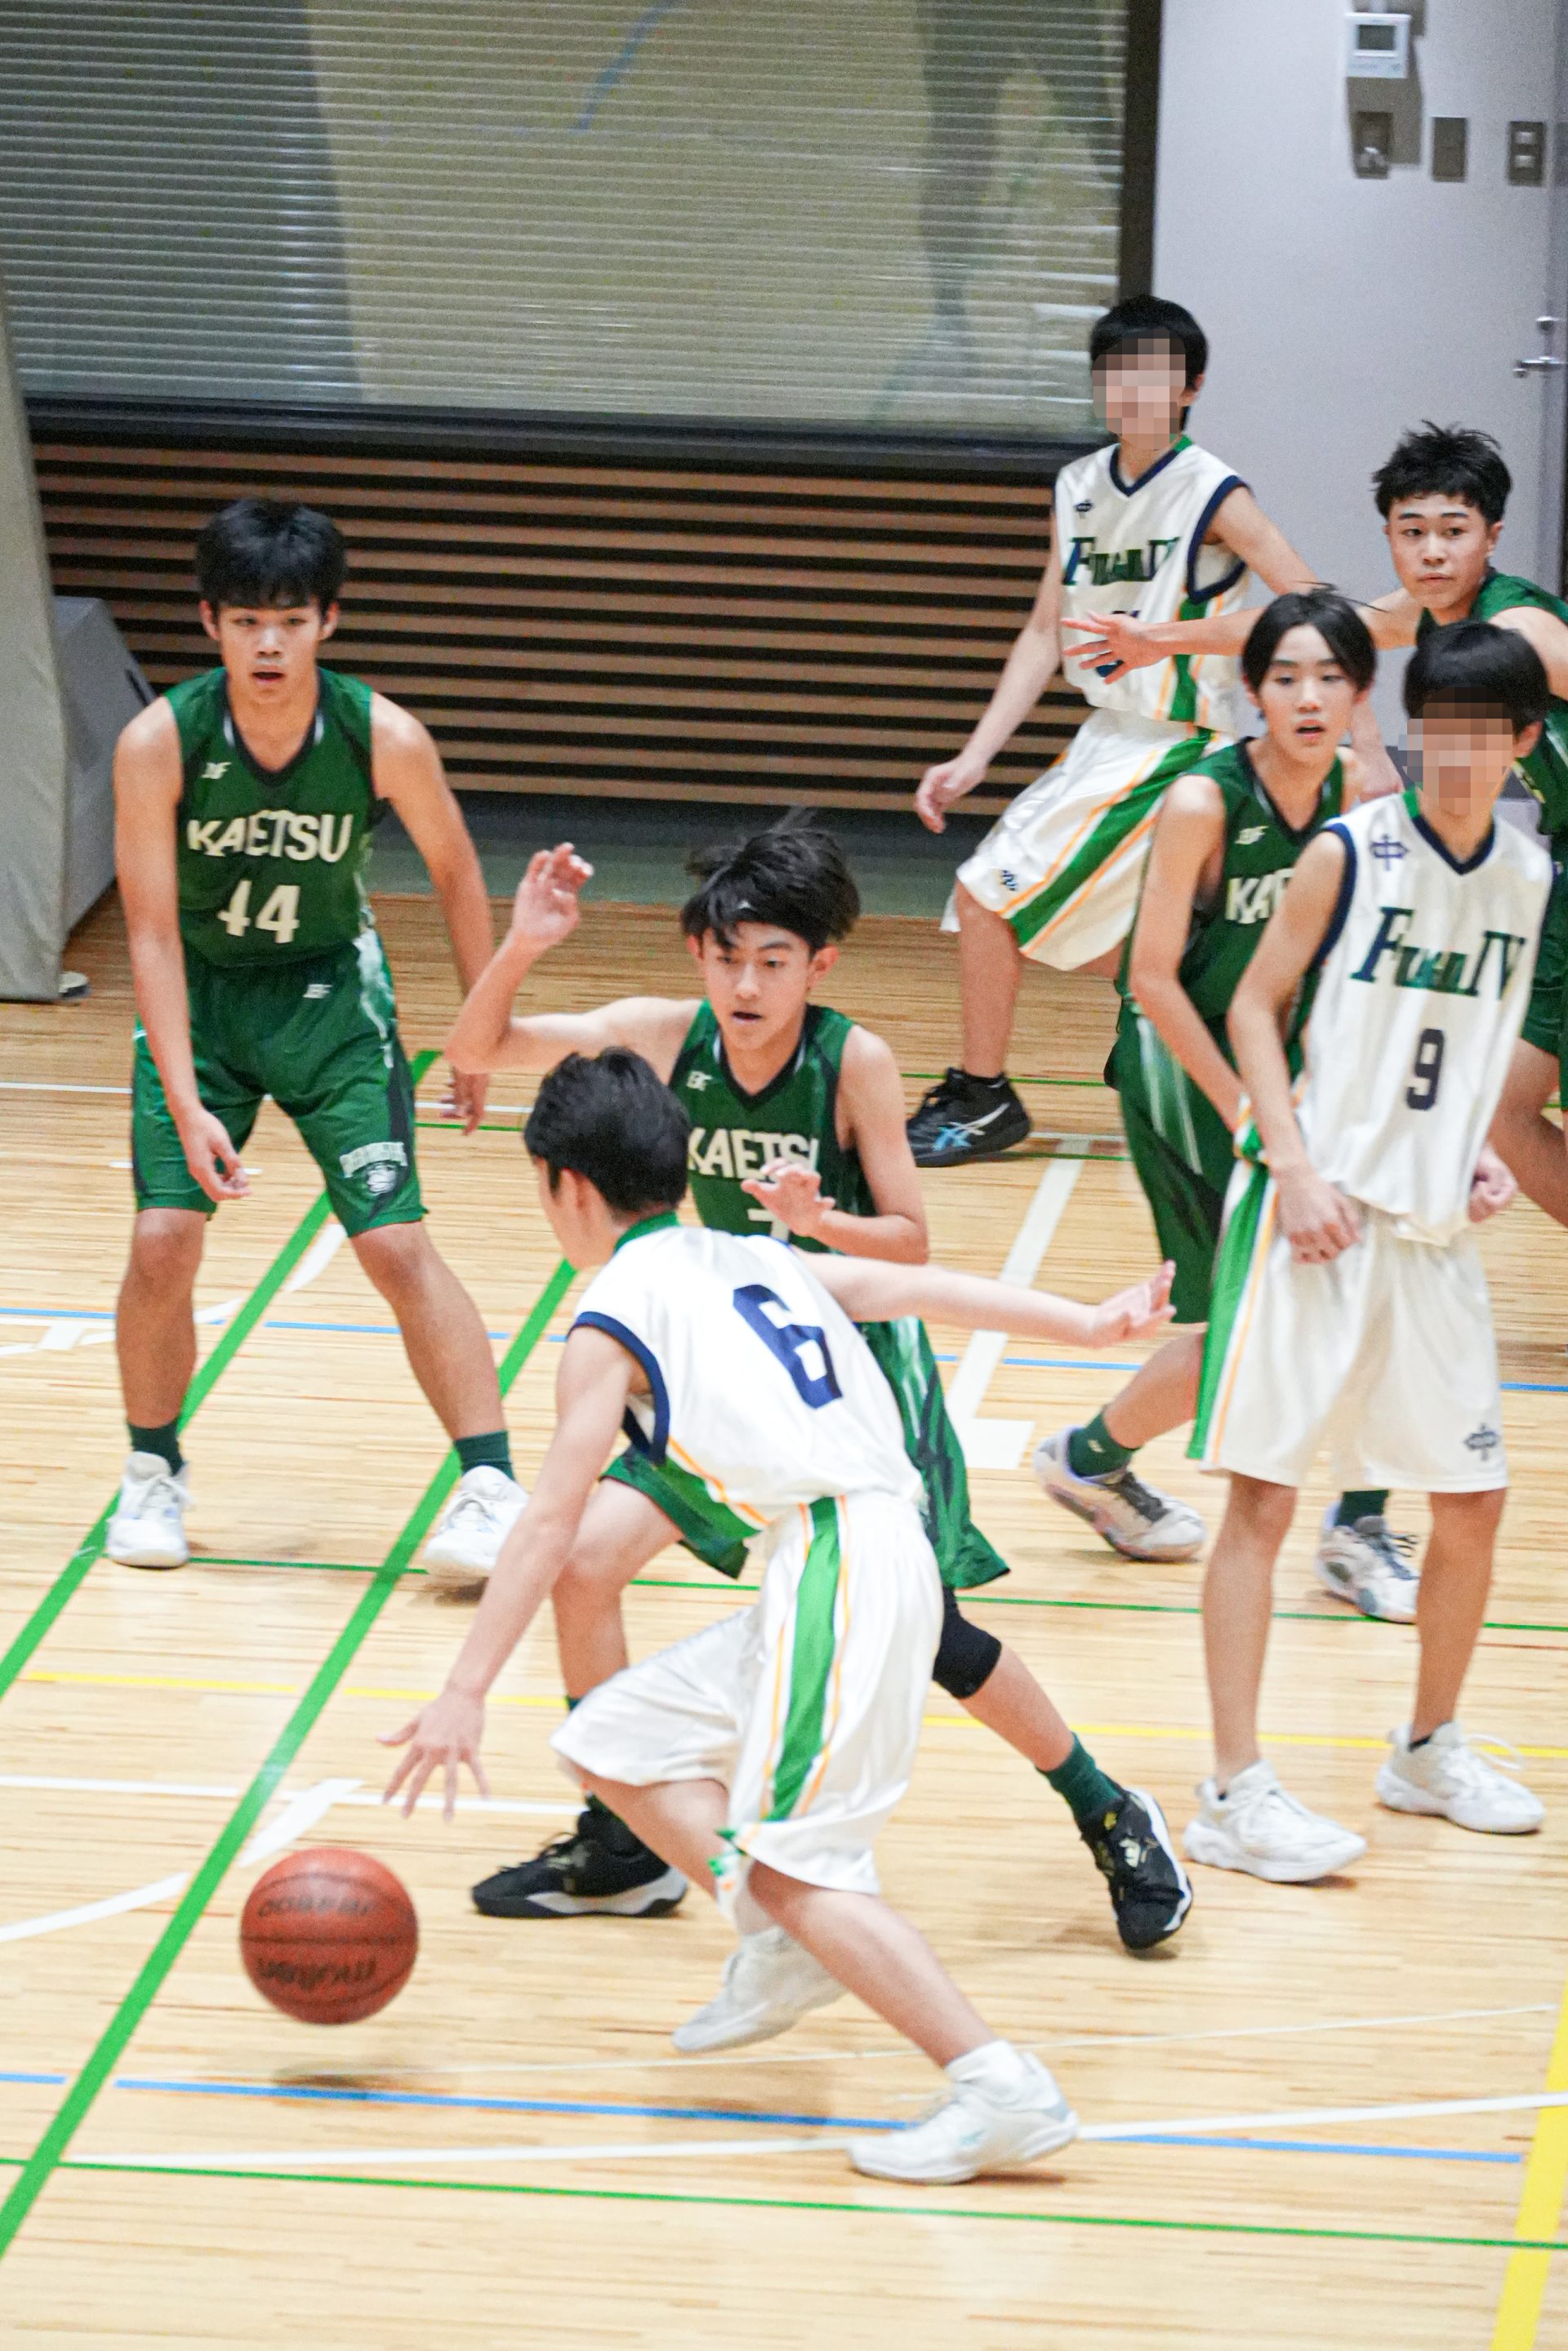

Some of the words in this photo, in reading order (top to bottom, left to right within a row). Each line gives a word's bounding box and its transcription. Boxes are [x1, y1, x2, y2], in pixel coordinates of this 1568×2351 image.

[186, 809, 353, 863] KAETSU
[217, 879, 300, 944] 44
[1405, 1028, 1445, 1111] 9
[733, 1284, 843, 1409] 6
